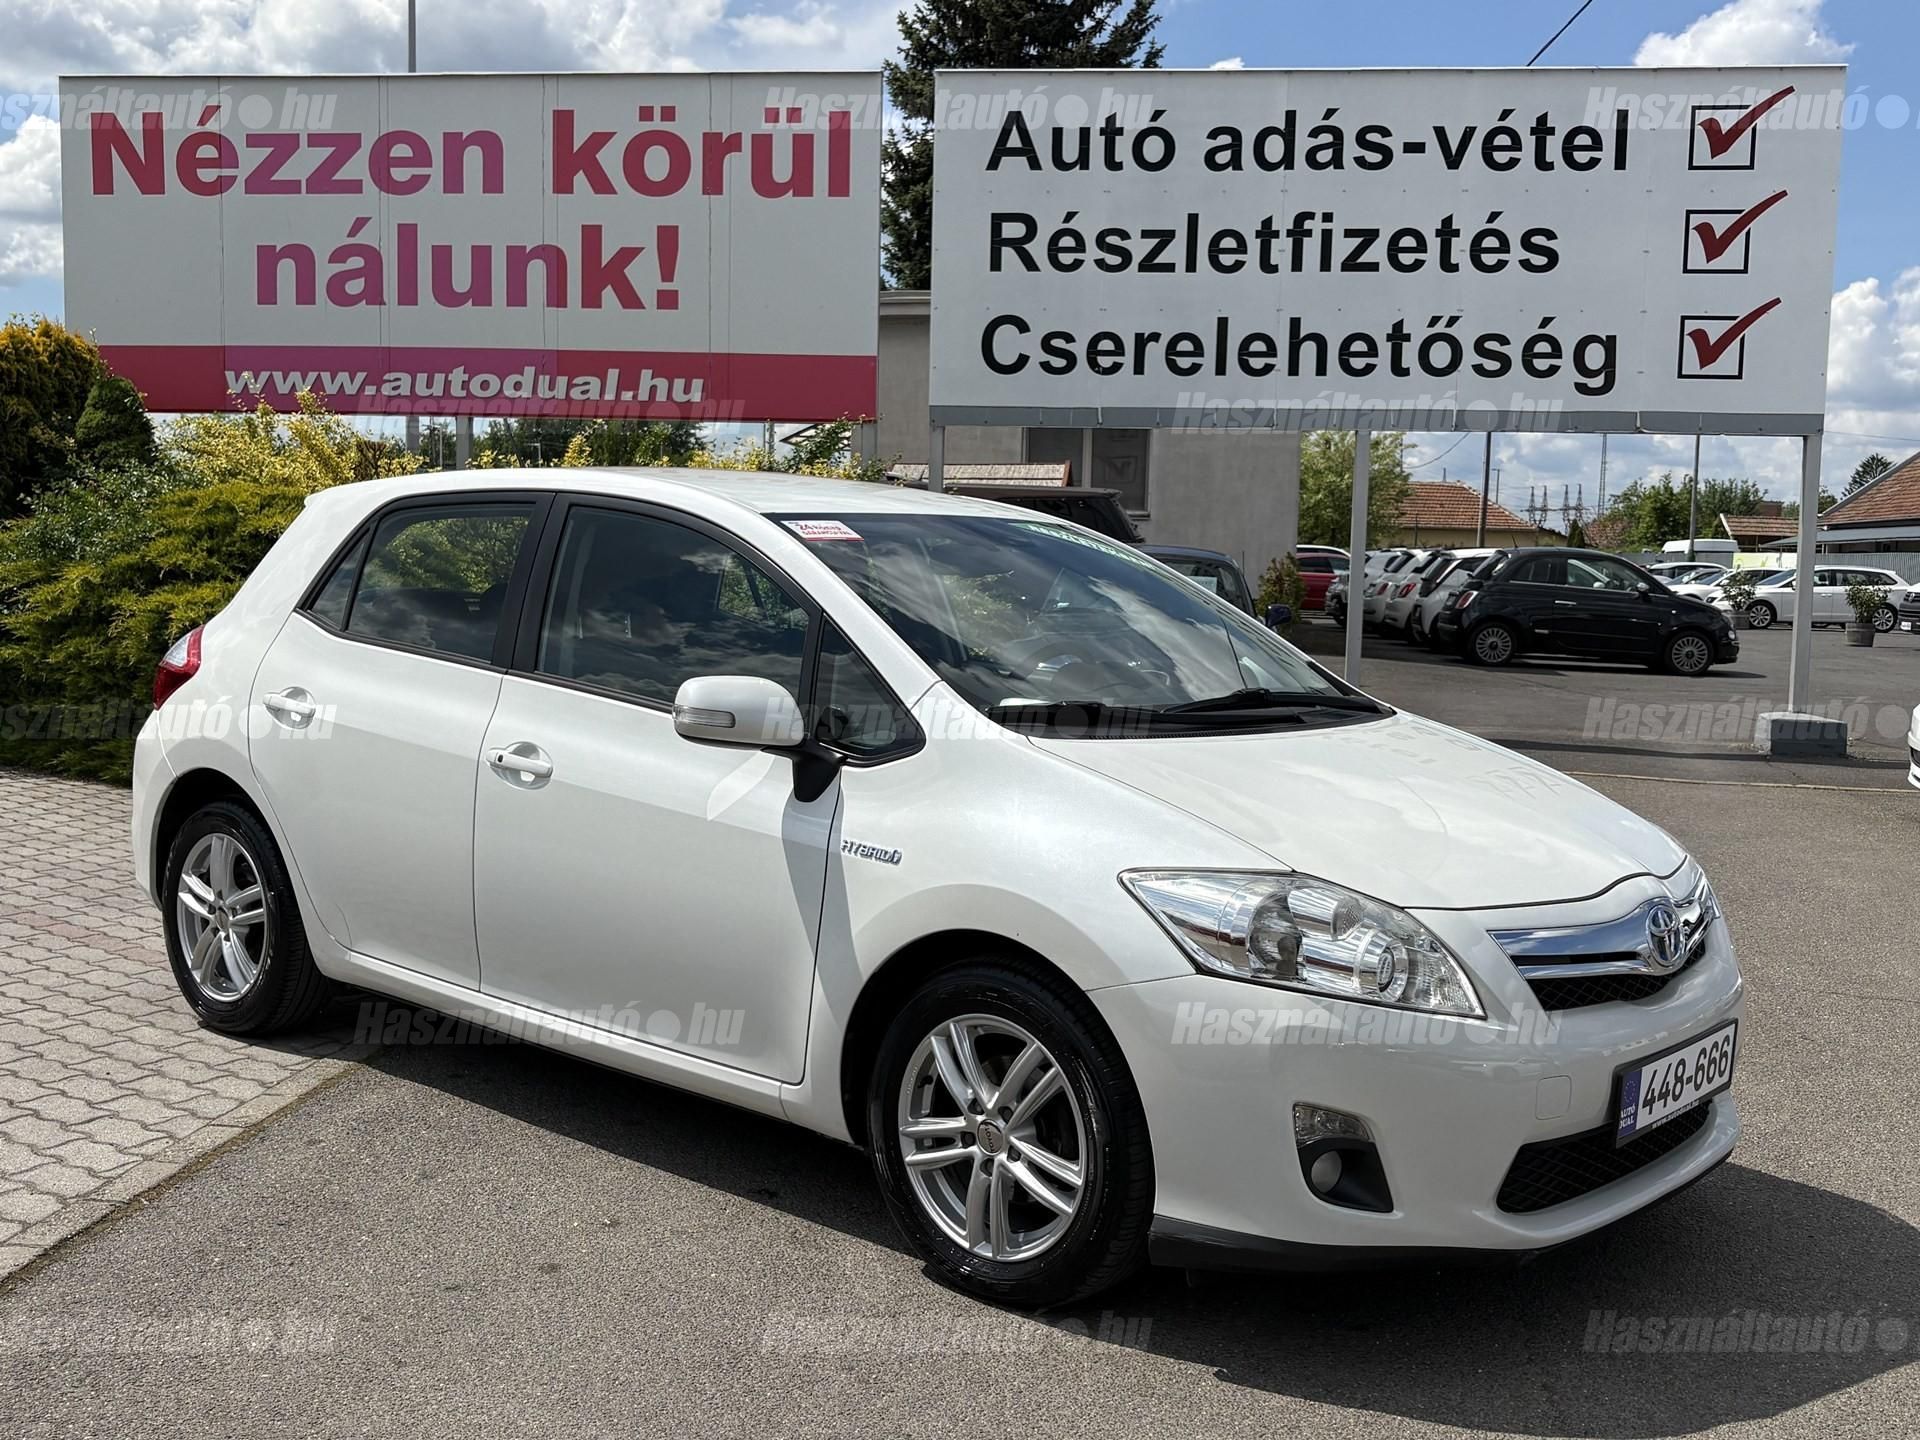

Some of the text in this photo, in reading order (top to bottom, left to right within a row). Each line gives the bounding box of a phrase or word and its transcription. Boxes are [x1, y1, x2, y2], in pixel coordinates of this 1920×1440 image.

[92, 105, 851, 198] Nézzen körül
[985, 108, 1629, 172] Autó adás-vétel
[256, 216, 680, 311] nálunk!
[990, 211, 1560, 275] Részletfizetés
[224, 365, 704, 403] www.autodual.hu
[981, 314, 1617, 397] Cserelehetőség
[1641, 1034, 1731, 1116] 448-666
